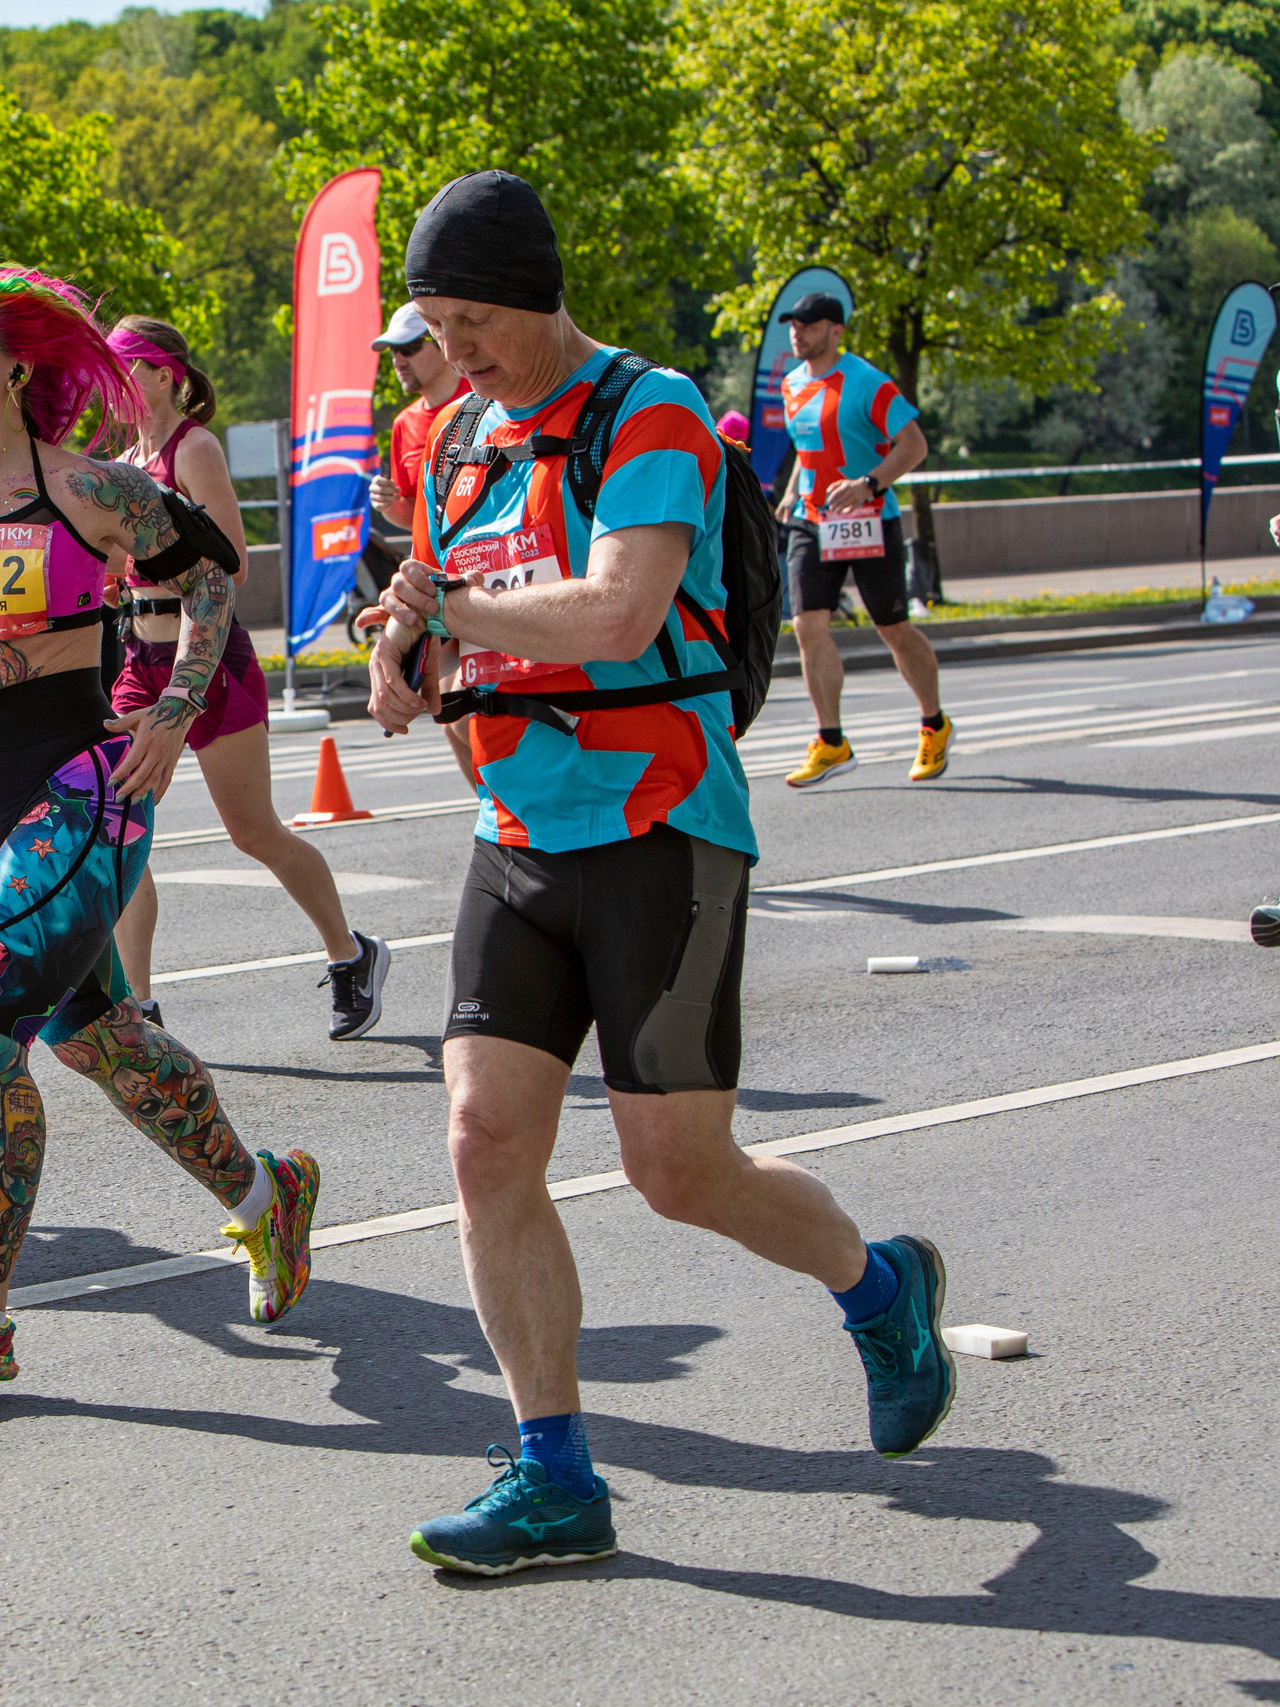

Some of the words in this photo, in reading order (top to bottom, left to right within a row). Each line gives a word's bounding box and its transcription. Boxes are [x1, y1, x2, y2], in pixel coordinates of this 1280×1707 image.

[828, 520, 872, 540] 7581
[452, 542, 500, 559] МОСКОВСКИЙ
[520, 549, 539, 559] 2023
[465, 658, 477, 683] G
